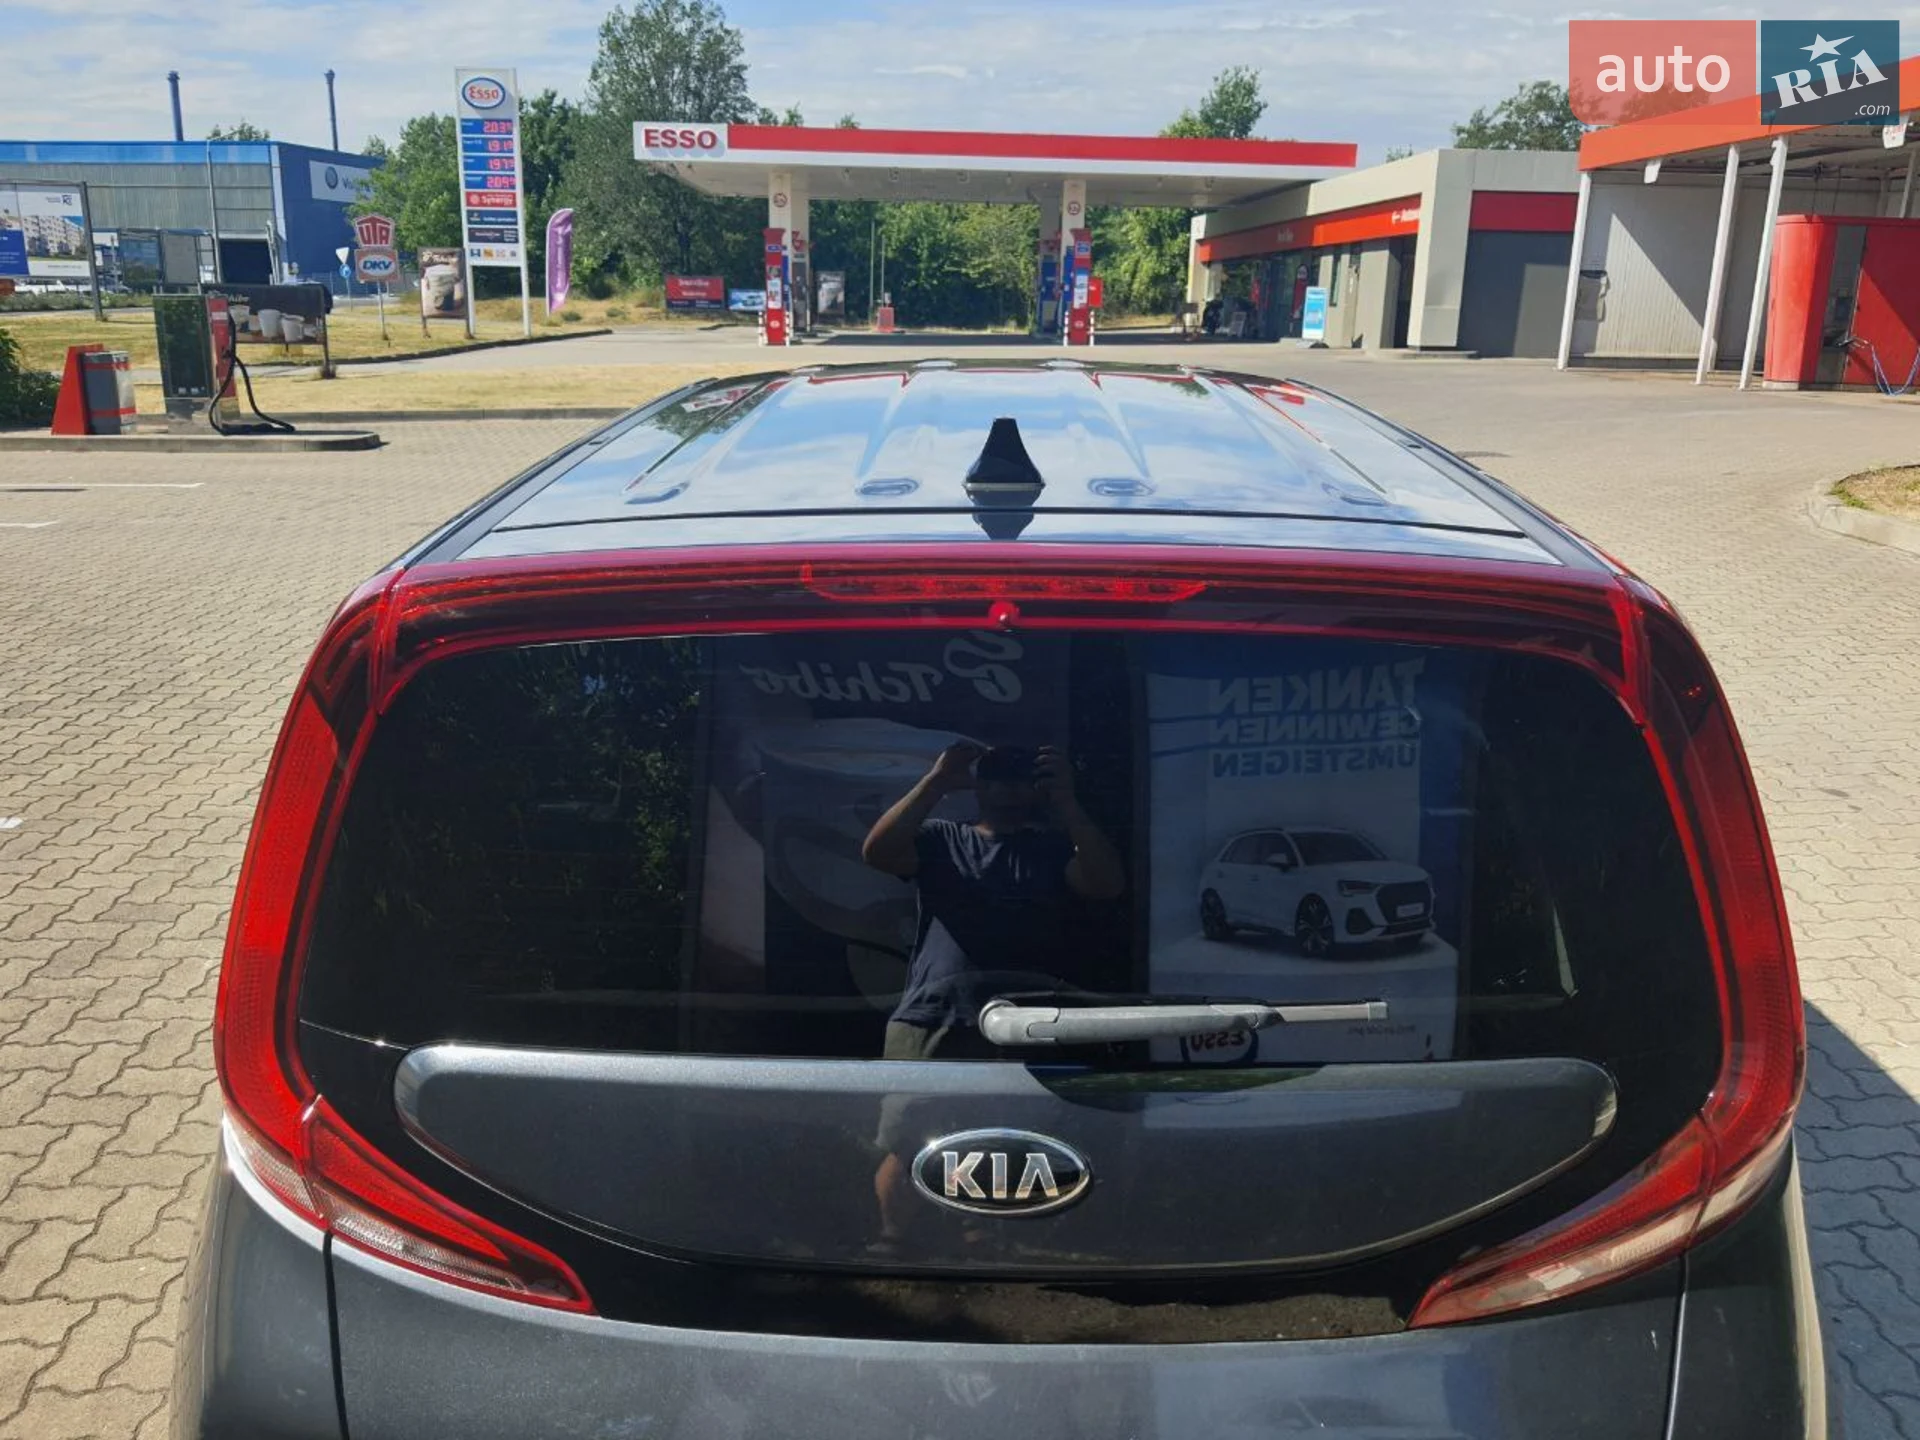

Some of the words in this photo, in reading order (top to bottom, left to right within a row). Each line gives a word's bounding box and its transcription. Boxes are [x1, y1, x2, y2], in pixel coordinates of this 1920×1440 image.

[468, 85, 499, 100] Esso
[644, 128, 718, 149] ESSO
[356, 216, 391, 246] UTA
[363, 260, 392, 270] DKV
[942, 1151, 1059, 1199] KIA
